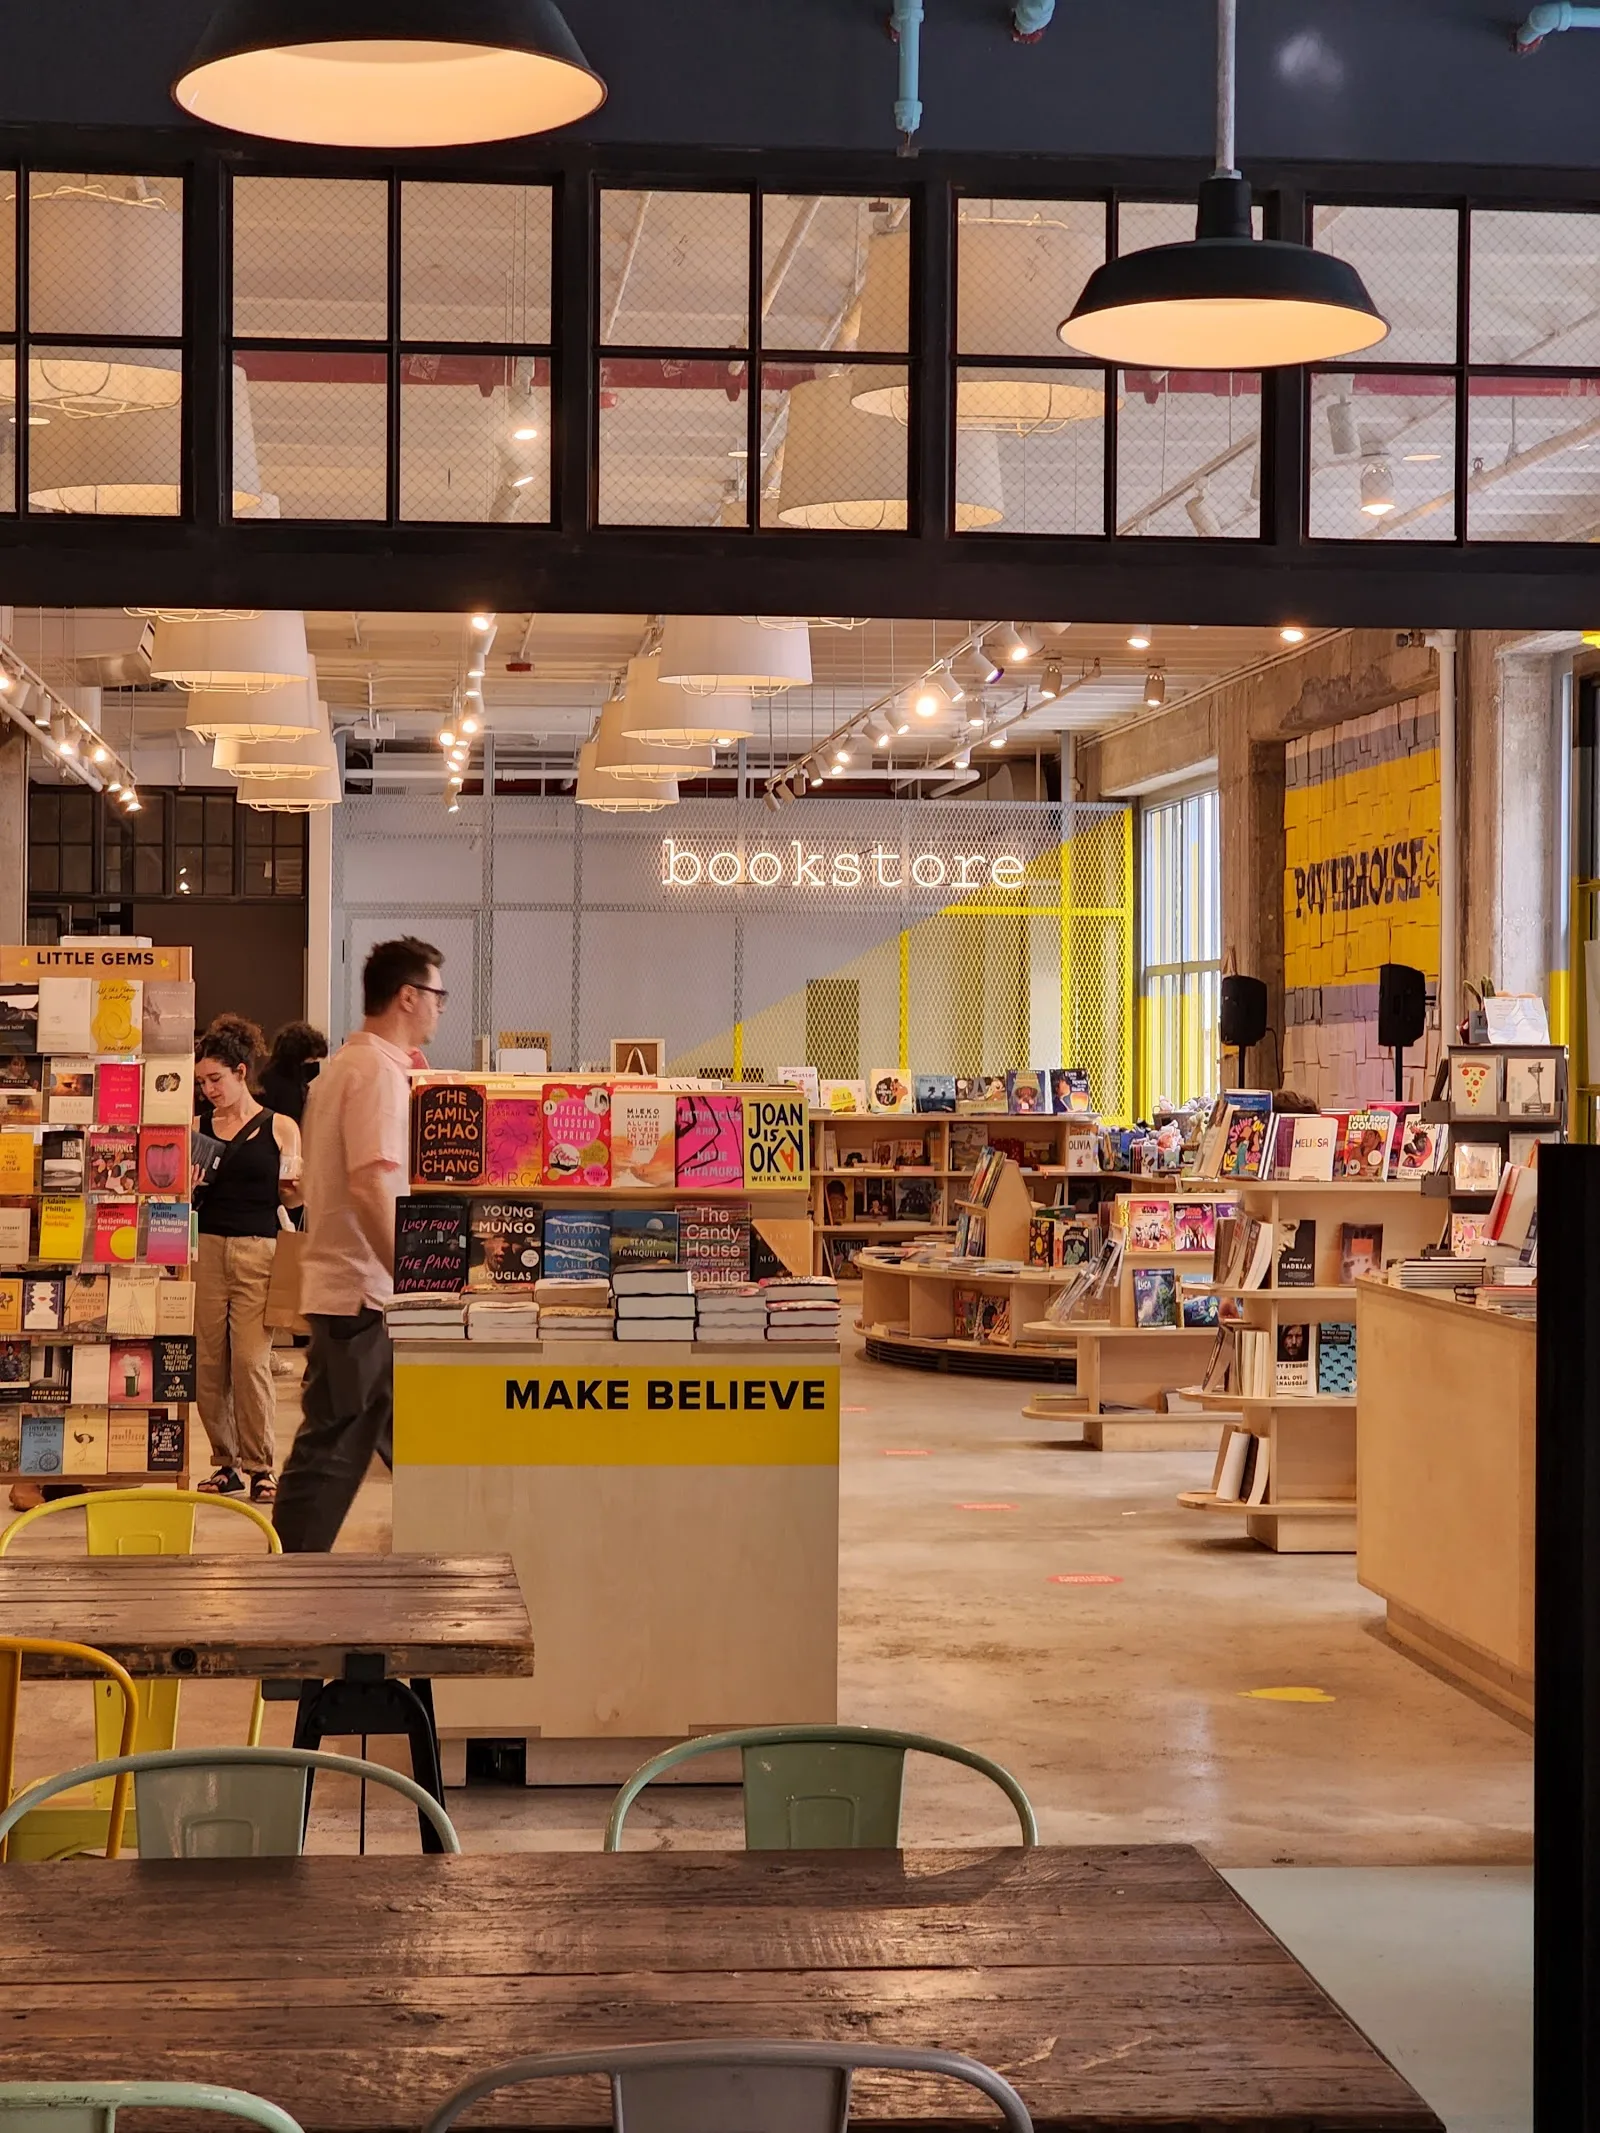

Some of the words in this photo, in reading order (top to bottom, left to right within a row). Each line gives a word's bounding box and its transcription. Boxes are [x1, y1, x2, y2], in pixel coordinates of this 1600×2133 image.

[662, 839, 1025, 888] bookstore
[37, 952, 95, 965] LITTLE
[101, 952, 155, 965] GEMS
[436, 1090, 467, 1105] THE
[425, 1107, 479, 1123] FAMILY
[560, 1105, 589, 1116] PEACH
[681, 1110, 741, 1121] INTIMACIES
[553, 1118, 595, 1129] BLOSSOM
[748, 1103, 803, 1139] JOAN
[1348, 1122, 1388, 1130] LOOKING
[424, 1123, 479, 1140] CHAO
[557, 1130, 591, 1141] SPRING
[764, 1129, 779, 1142] IS
[1068, 1141, 1091, 1150] OLIVIA
[1295, 1138, 1329, 1148] MELISSA
[421, 1149, 437, 1158] LAN
[438, 1148, 480, 1158] SAMANTHA
[697, 1151, 728, 1161] KATIE
[750, 1129, 804, 1173] OKAY
[422, 1160, 479, 1173] CHANG
[683, 1166, 740, 1177] KITAMURA
[487, 1170, 543, 1186] CIRCA
[45, 1205, 72, 1213] Phillips
[482, 1205, 534, 1218] YOUNG
[697, 1207, 729, 1222] The
[151, 1211, 177, 1219] Phillips
[97, 1217, 107, 1225] On
[108, 1217, 132, 1226] Getting
[161, 1219, 188, 1227] Wanting
[402, 1219, 428, 1233] LUCY
[429, 1219, 460, 1234] FOLEY
[158, 1226, 183, 1234] Change
[479, 1221, 536, 1234] MUNGO
[554, 1225, 601, 1234] AMANDA
[686, 1224, 740, 1243] Candy
[554, 1239, 601, 1247] GORMAN
[630, 1239, 644, 1247] SEA
[647, 1239, 658, 1247] OF
[618, 1248, 669, 1257] TRANQUILITY
[686, 1241, 740, 1257] House
[399, 1255, 421, 1271] THE
[423, 1254, 461, 1273] PARIS
[556, 1260, 584, 1269] CALL
[587, 1260, 600, 1269] US
[478, 1271, 532, 1281] DOUGLAS
[690, 1267, 748, 1283] ennifer
[397, 1277, 461, 1292] APARTMENT
[1137, 1280, 1151, 1290] LUCA
[164, 1390, 188, 1398] WATTS
[505, 1380, 629, 1410] MAKE
[647, 1380, 825, 1410] BELIEVE
